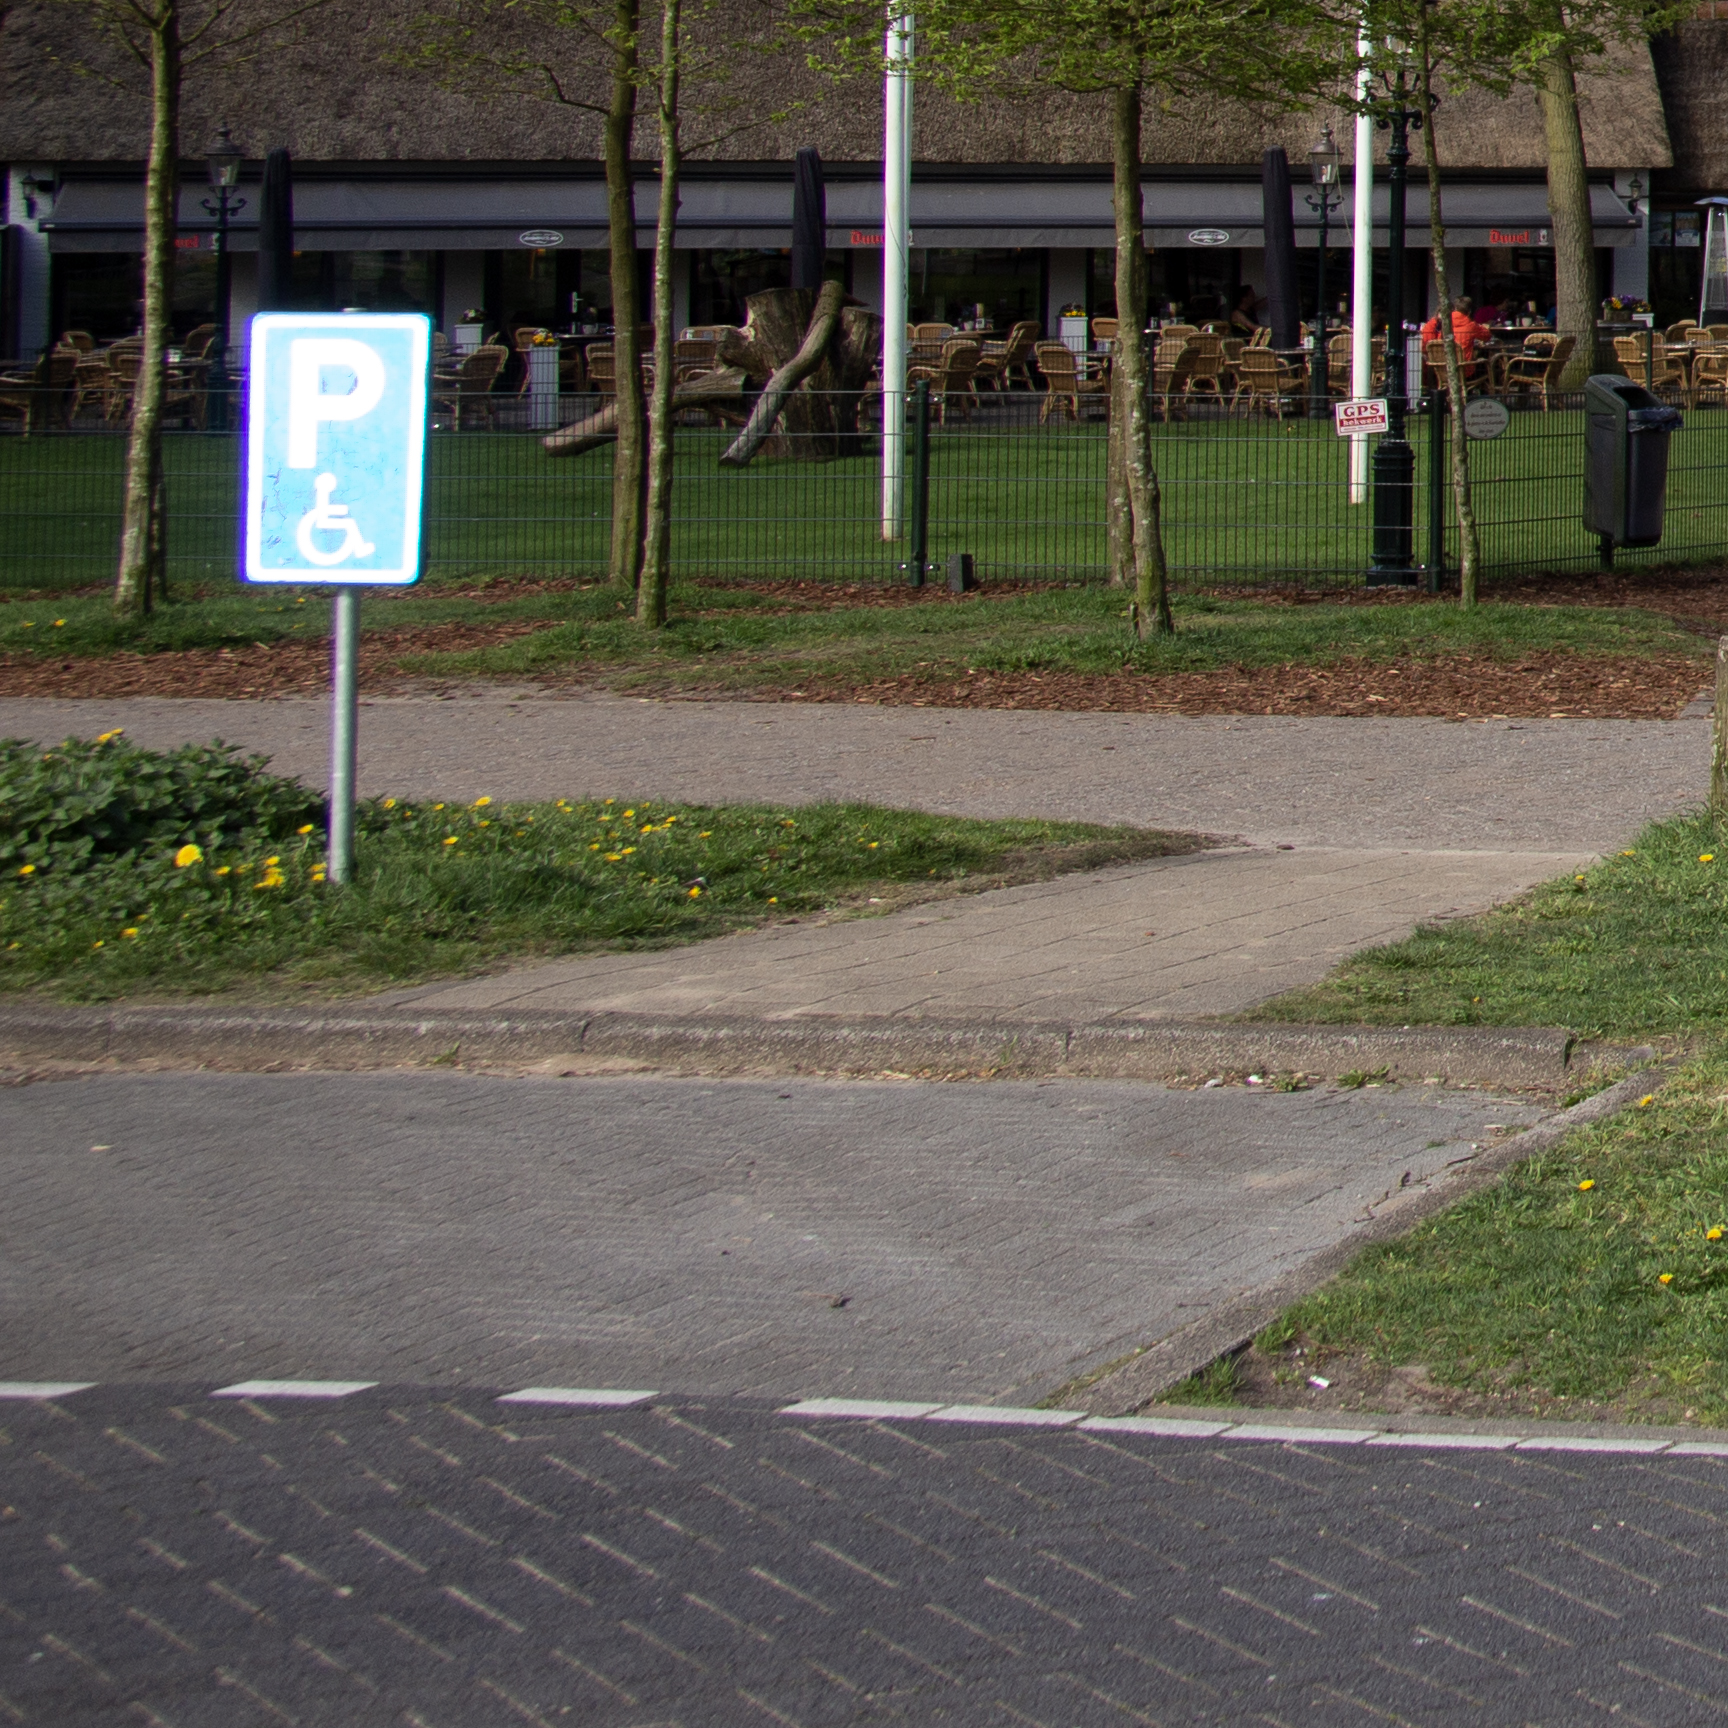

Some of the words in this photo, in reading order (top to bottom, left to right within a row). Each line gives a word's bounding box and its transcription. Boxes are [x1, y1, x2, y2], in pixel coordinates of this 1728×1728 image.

[1489, 229, 1530, 244] Duvel
[287, 338, 385, 469] P
[1343, 403, 1380, 417] GPS
[1342, 415, 1383, 426] hekwerk
